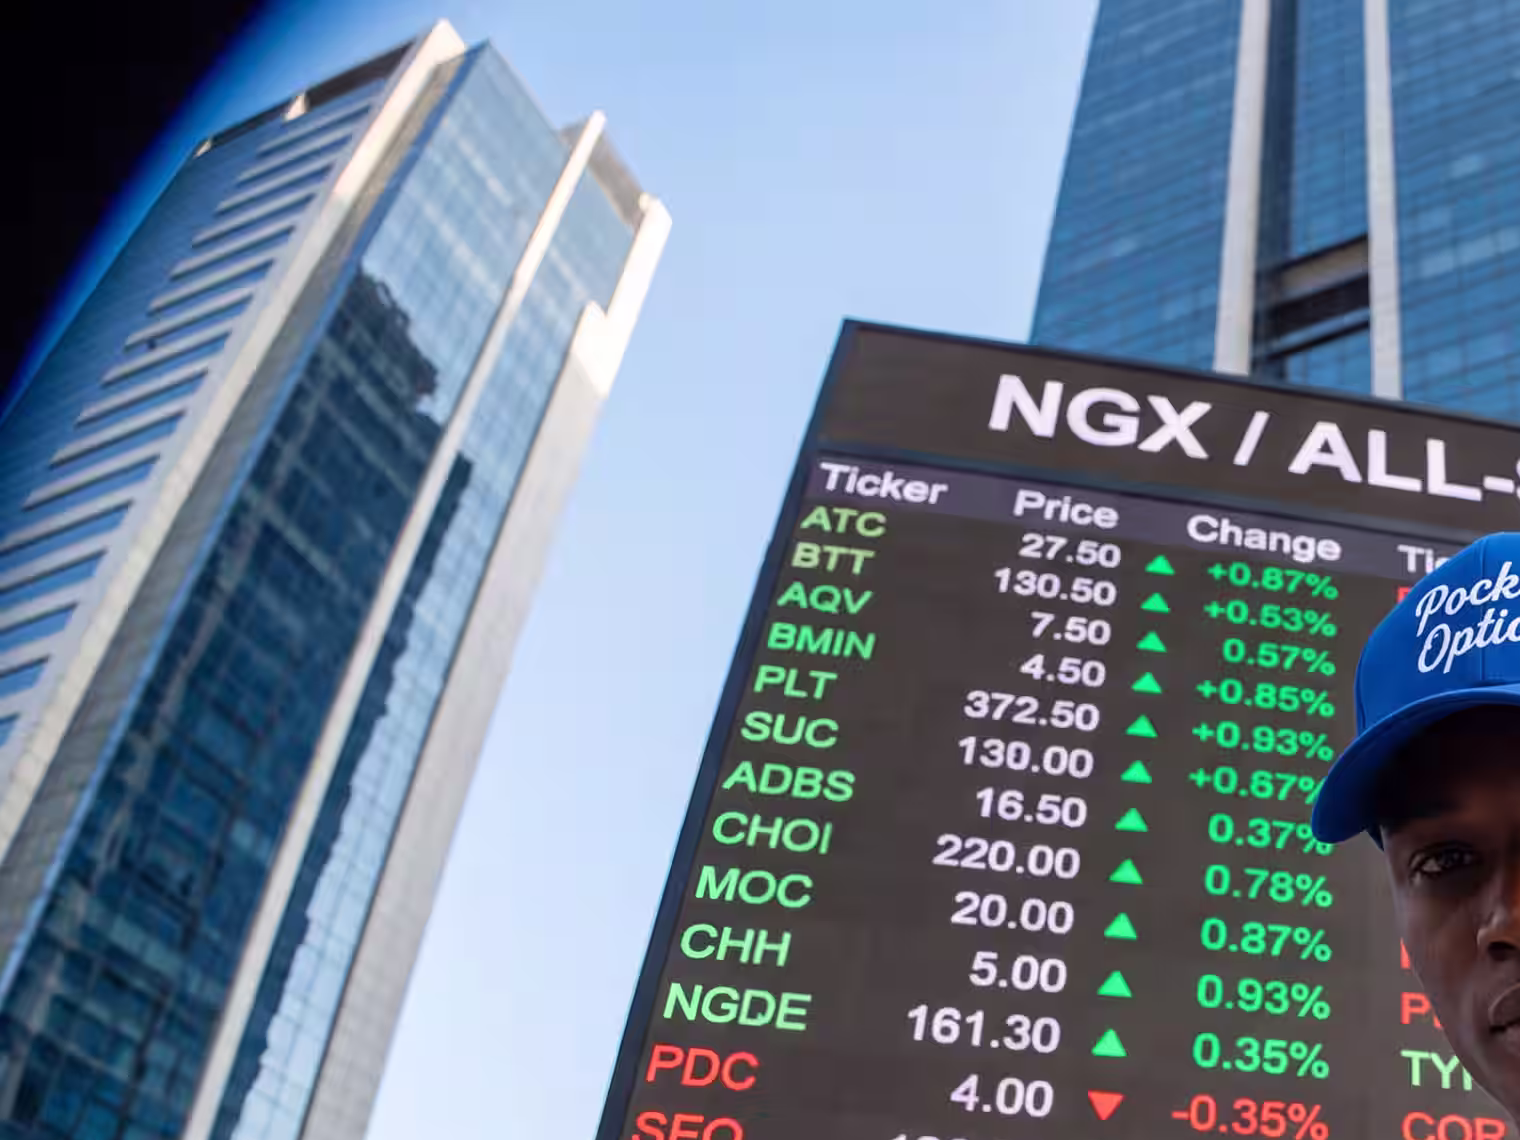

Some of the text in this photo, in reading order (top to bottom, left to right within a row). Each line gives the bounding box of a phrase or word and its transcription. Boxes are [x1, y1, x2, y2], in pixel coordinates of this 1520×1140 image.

[989, 374, 1211, 458] NGX
[801, 506, 1338, 600] ATC 27.50 +0.87%
[820, 462, 1341, 563] Ticker Price Change
[792, 542, 874, 574] BTT
[995, 568, 1116, 605] 130.50
[768, 622, 1334, 717] BMIN 4.50 +0.85%
[777, 582, 1336, 676] AQV 7.50 0.57%
[754, 665, 837, 698] PLT
[965, 691, 1099, 731] 372.50
[741, 712, 838, 748] SUC
[959, 737, 1093, 778] 130.00
[722, 761, 855, 802] ADBS
[977, 788, 1087, 827] 16.50
[696, 866, 812, 908] MOC
[951, 892, 1074, 934] 20.00
[713, 812, 1332, 907] CHOI 220.00 0.78%
[681, 924, 1330, 1020] CHH 5.00 0.93%
[663, 983, 1329, 1078] NGDE 161.30 0.35%
[646, 1045, 759, 1090] PDC
[951, 1075, 1053, 1117] 4.00
